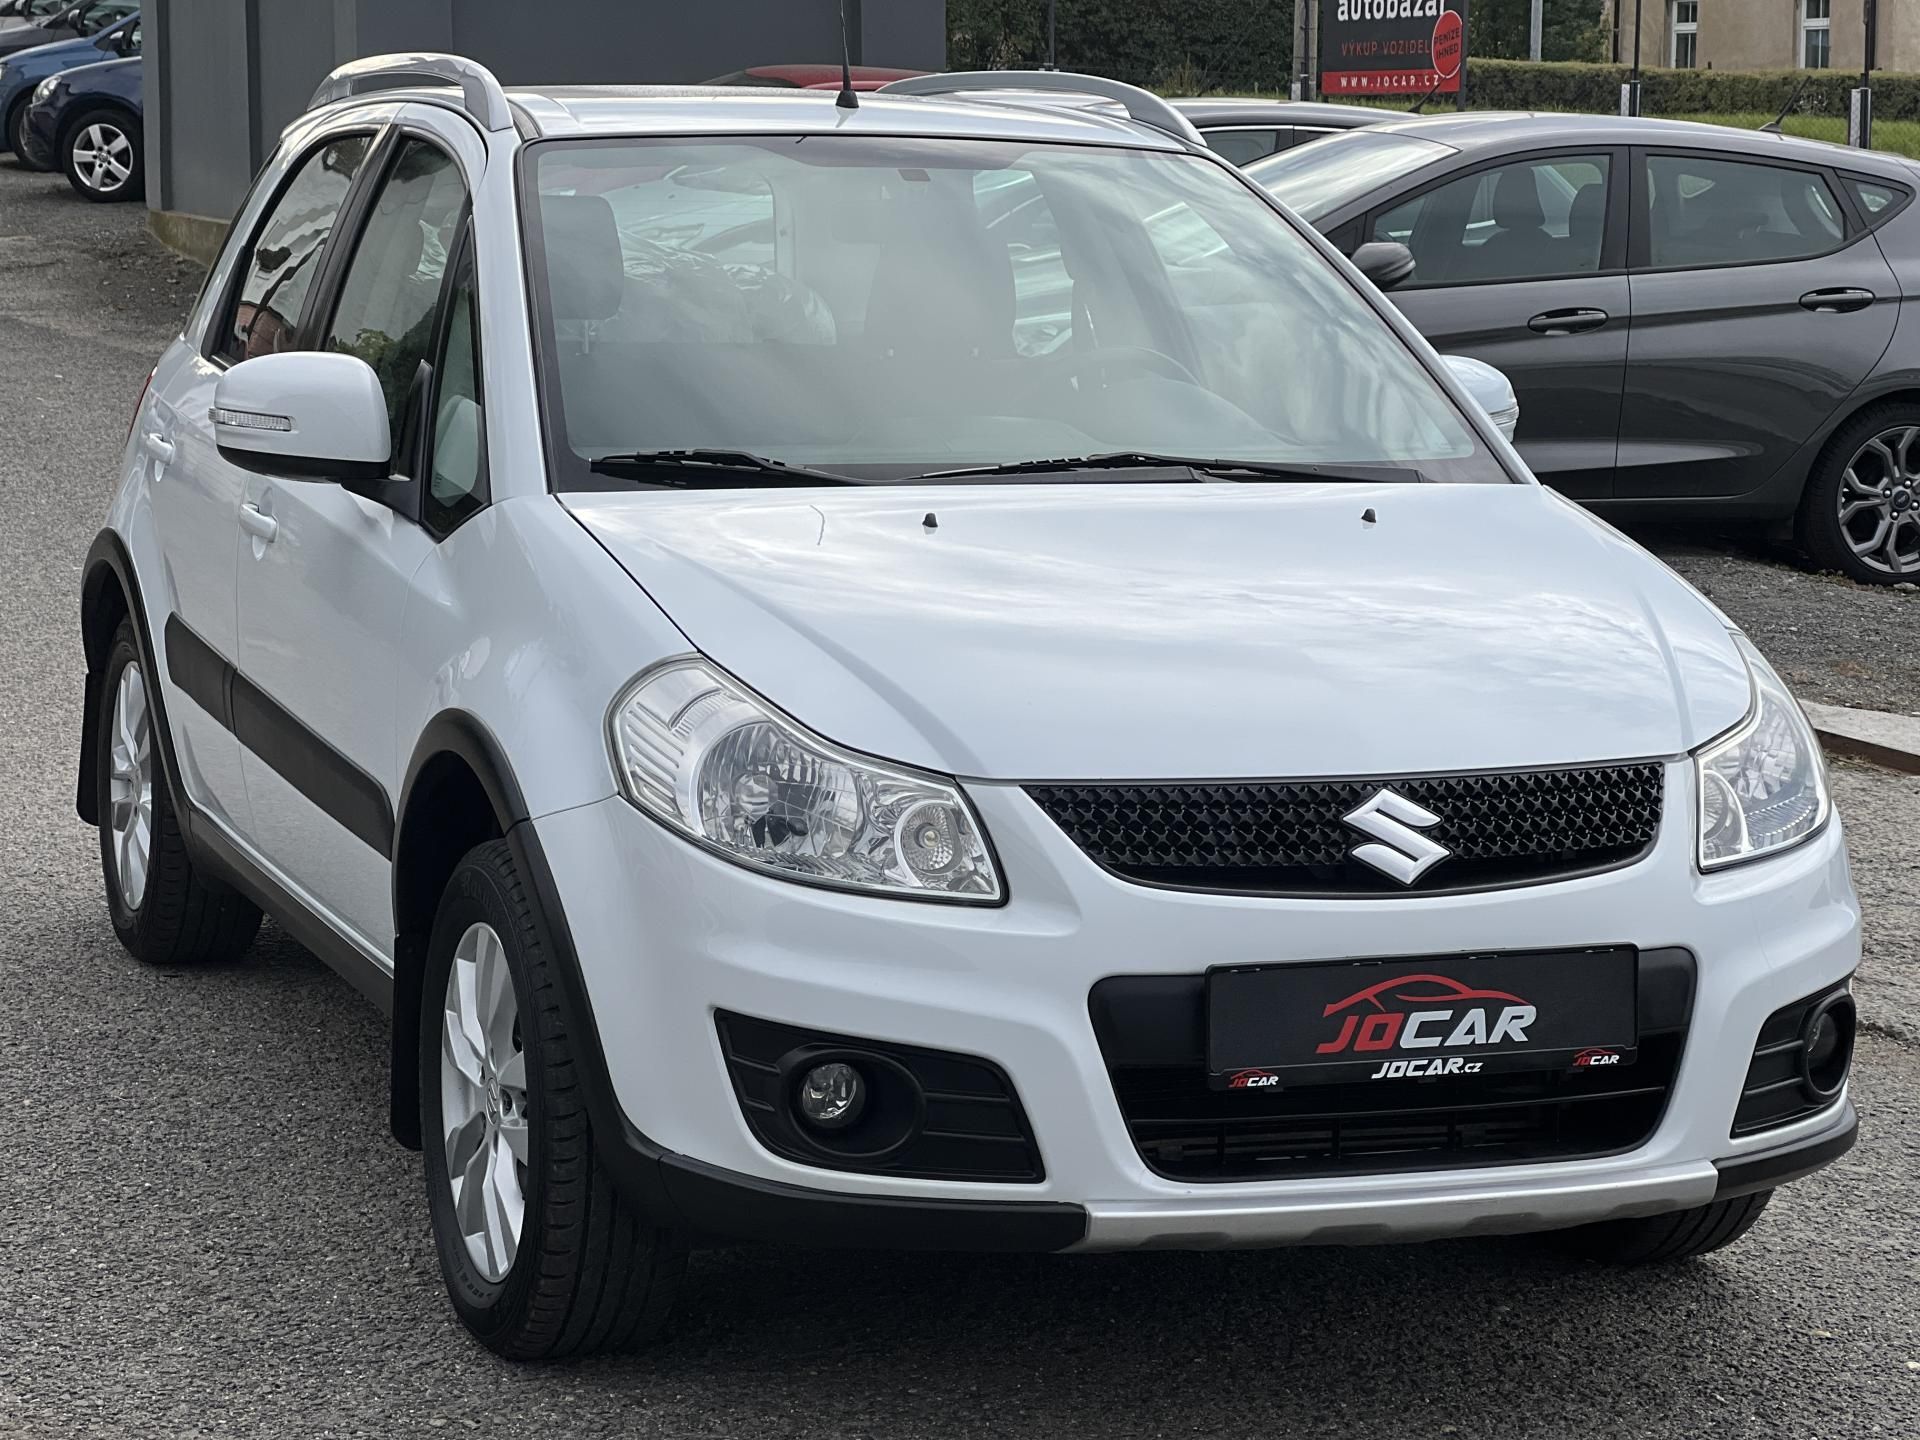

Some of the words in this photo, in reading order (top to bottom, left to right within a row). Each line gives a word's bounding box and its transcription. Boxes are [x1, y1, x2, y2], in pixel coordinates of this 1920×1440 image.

[1383, 40, 1430, 56] VOZIDEL
[1341, 74, 1439, 88] WWW.JOCAR.CZ
[1316, 1005, 1537, 1054] JOCAR
[1572, 1054, 1620, 1066] JOCAR
[1228, 1075, 1279, 1088] JOCAR
